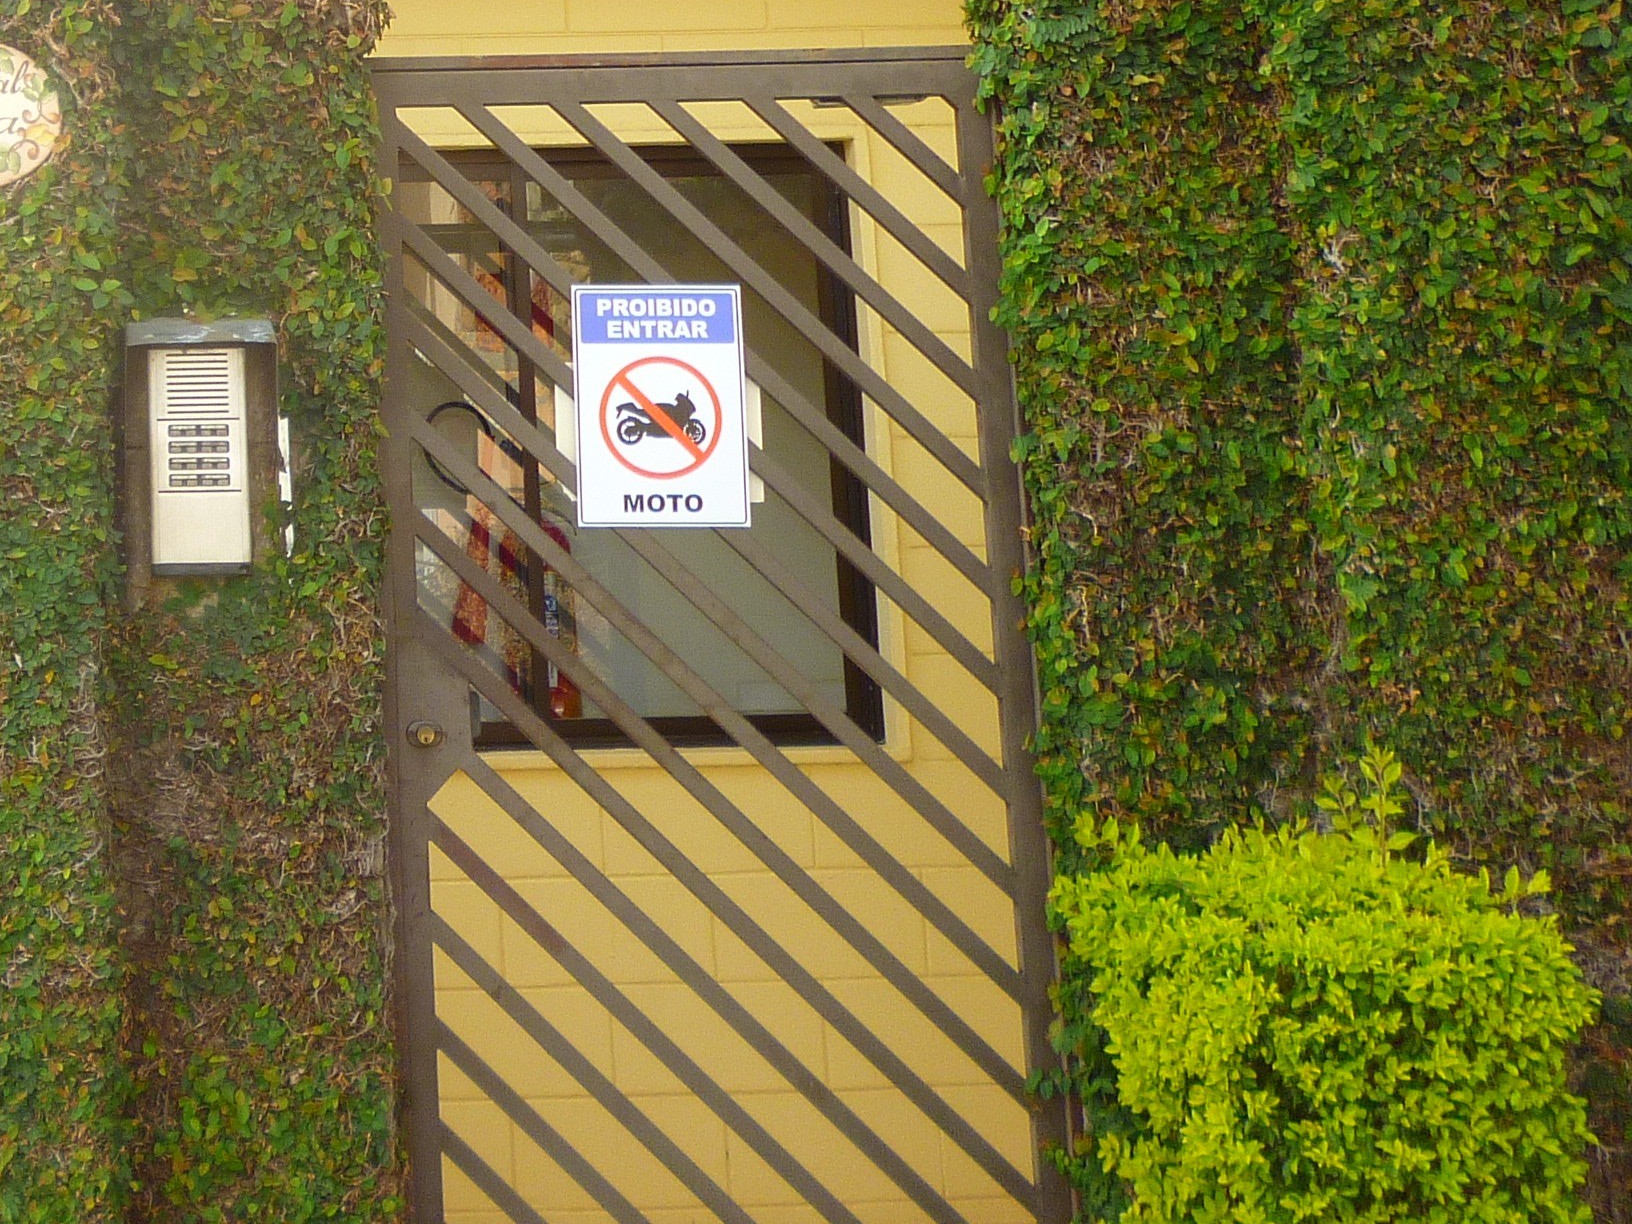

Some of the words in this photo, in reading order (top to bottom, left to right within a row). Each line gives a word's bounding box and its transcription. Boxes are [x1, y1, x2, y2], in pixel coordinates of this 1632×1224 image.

[596, 298, 717, 317] PROIBIDO
[607, 320, 709, 339] ENTRAR
[623, 494, 704, 513] MOTO
